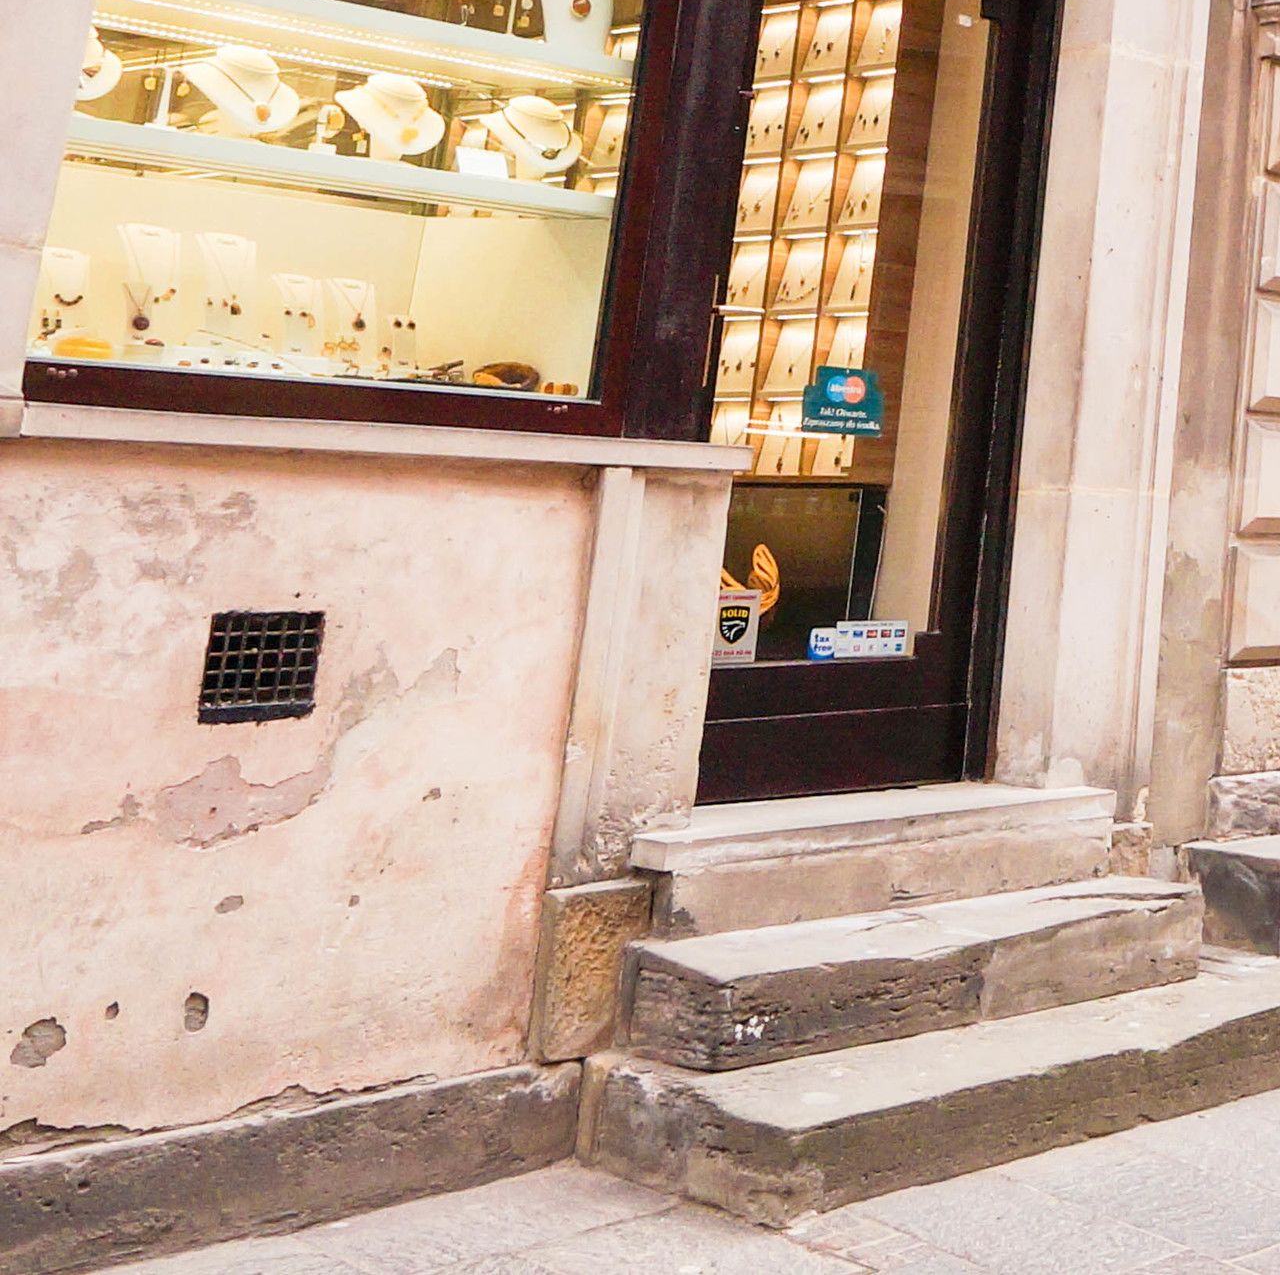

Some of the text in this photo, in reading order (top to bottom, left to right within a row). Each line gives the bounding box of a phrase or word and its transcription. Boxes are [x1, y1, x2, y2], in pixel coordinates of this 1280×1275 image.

[721, 609, 749, 618] SOLID
[814, 633, 829, 643] tax
[814, 643, 833, 652] free
